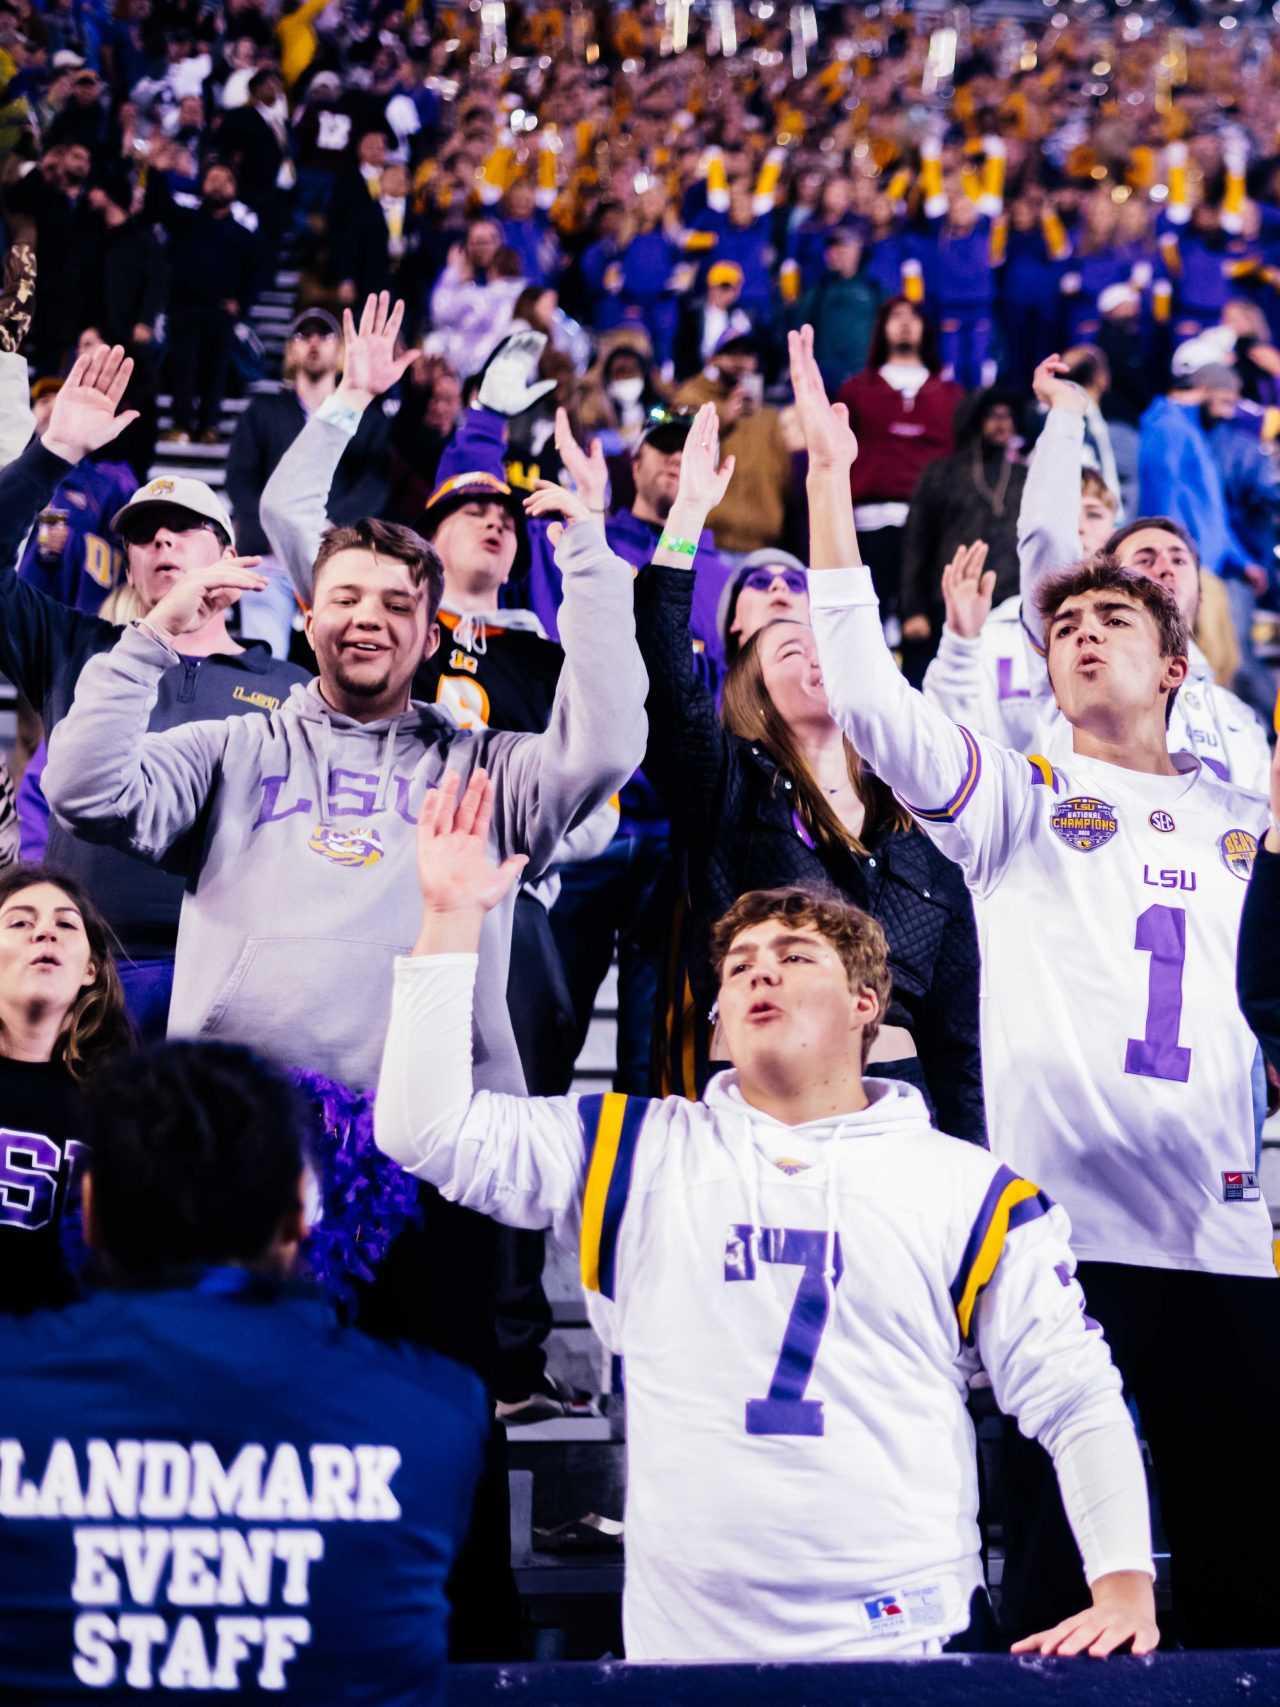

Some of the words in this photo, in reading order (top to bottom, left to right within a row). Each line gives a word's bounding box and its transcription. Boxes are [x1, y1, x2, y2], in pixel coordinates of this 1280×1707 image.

[1052, 817, 1116, 832] CHAMPIONS
[1152, 813, 1174, 831] SEC
[1144, 864, 1197, 892] LSU
[1124, 903, 1192, 1083] 1
[724, 1223, 844, 1436] 7
[0, 1438, 402, 1520] LANDMARK
[72, 1526, 325, 1607] EVENT
[73, 1612, 311, 1690] STAFF
